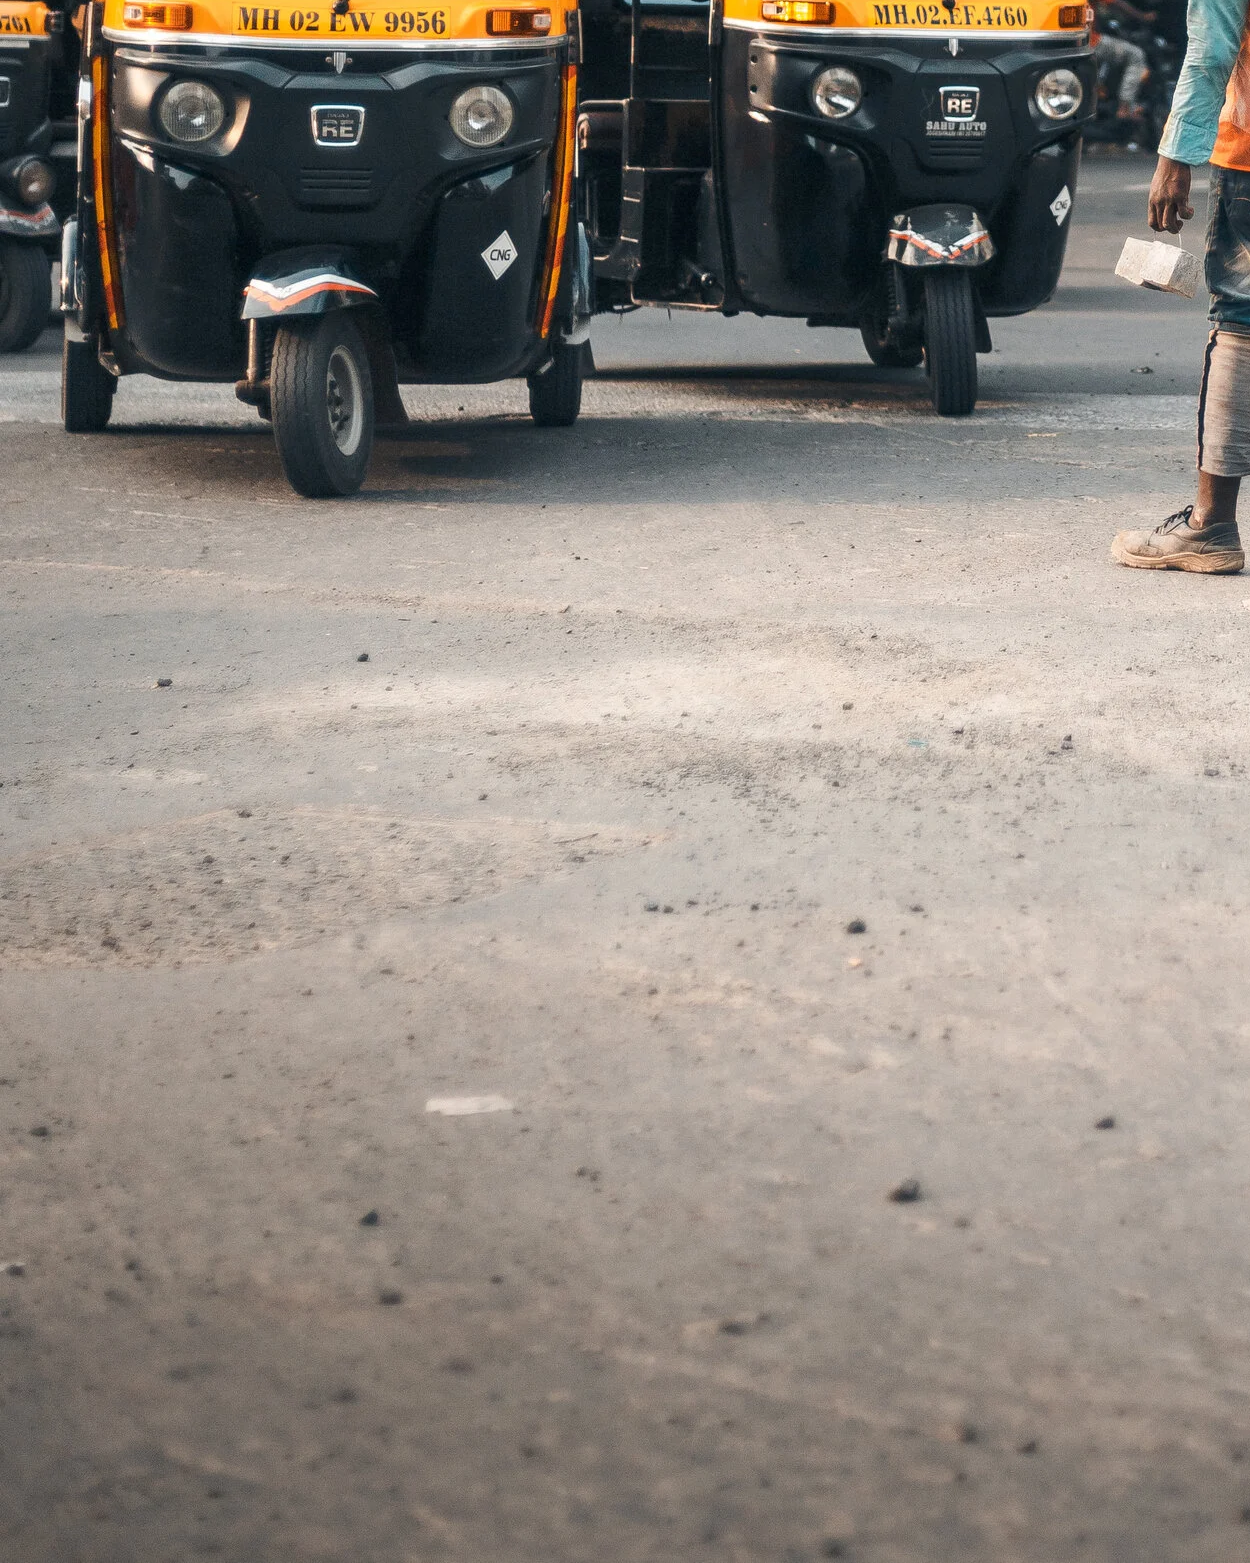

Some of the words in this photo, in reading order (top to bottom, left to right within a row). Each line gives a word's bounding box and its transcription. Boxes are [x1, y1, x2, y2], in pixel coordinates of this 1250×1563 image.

[237, 6, 281, 31] MH
[289, 9, 320, 32] 02
[328, 12, 376, 33] EW
[383, 10, 446, 35] 9956
[947, 98, 973, 114] RE
[321, 119, 355, 138] RE
[926, 121, 956, 131] SAHU
[958, 121, 987, 131] AUTO
[490, 249, 512, 261] CNG
